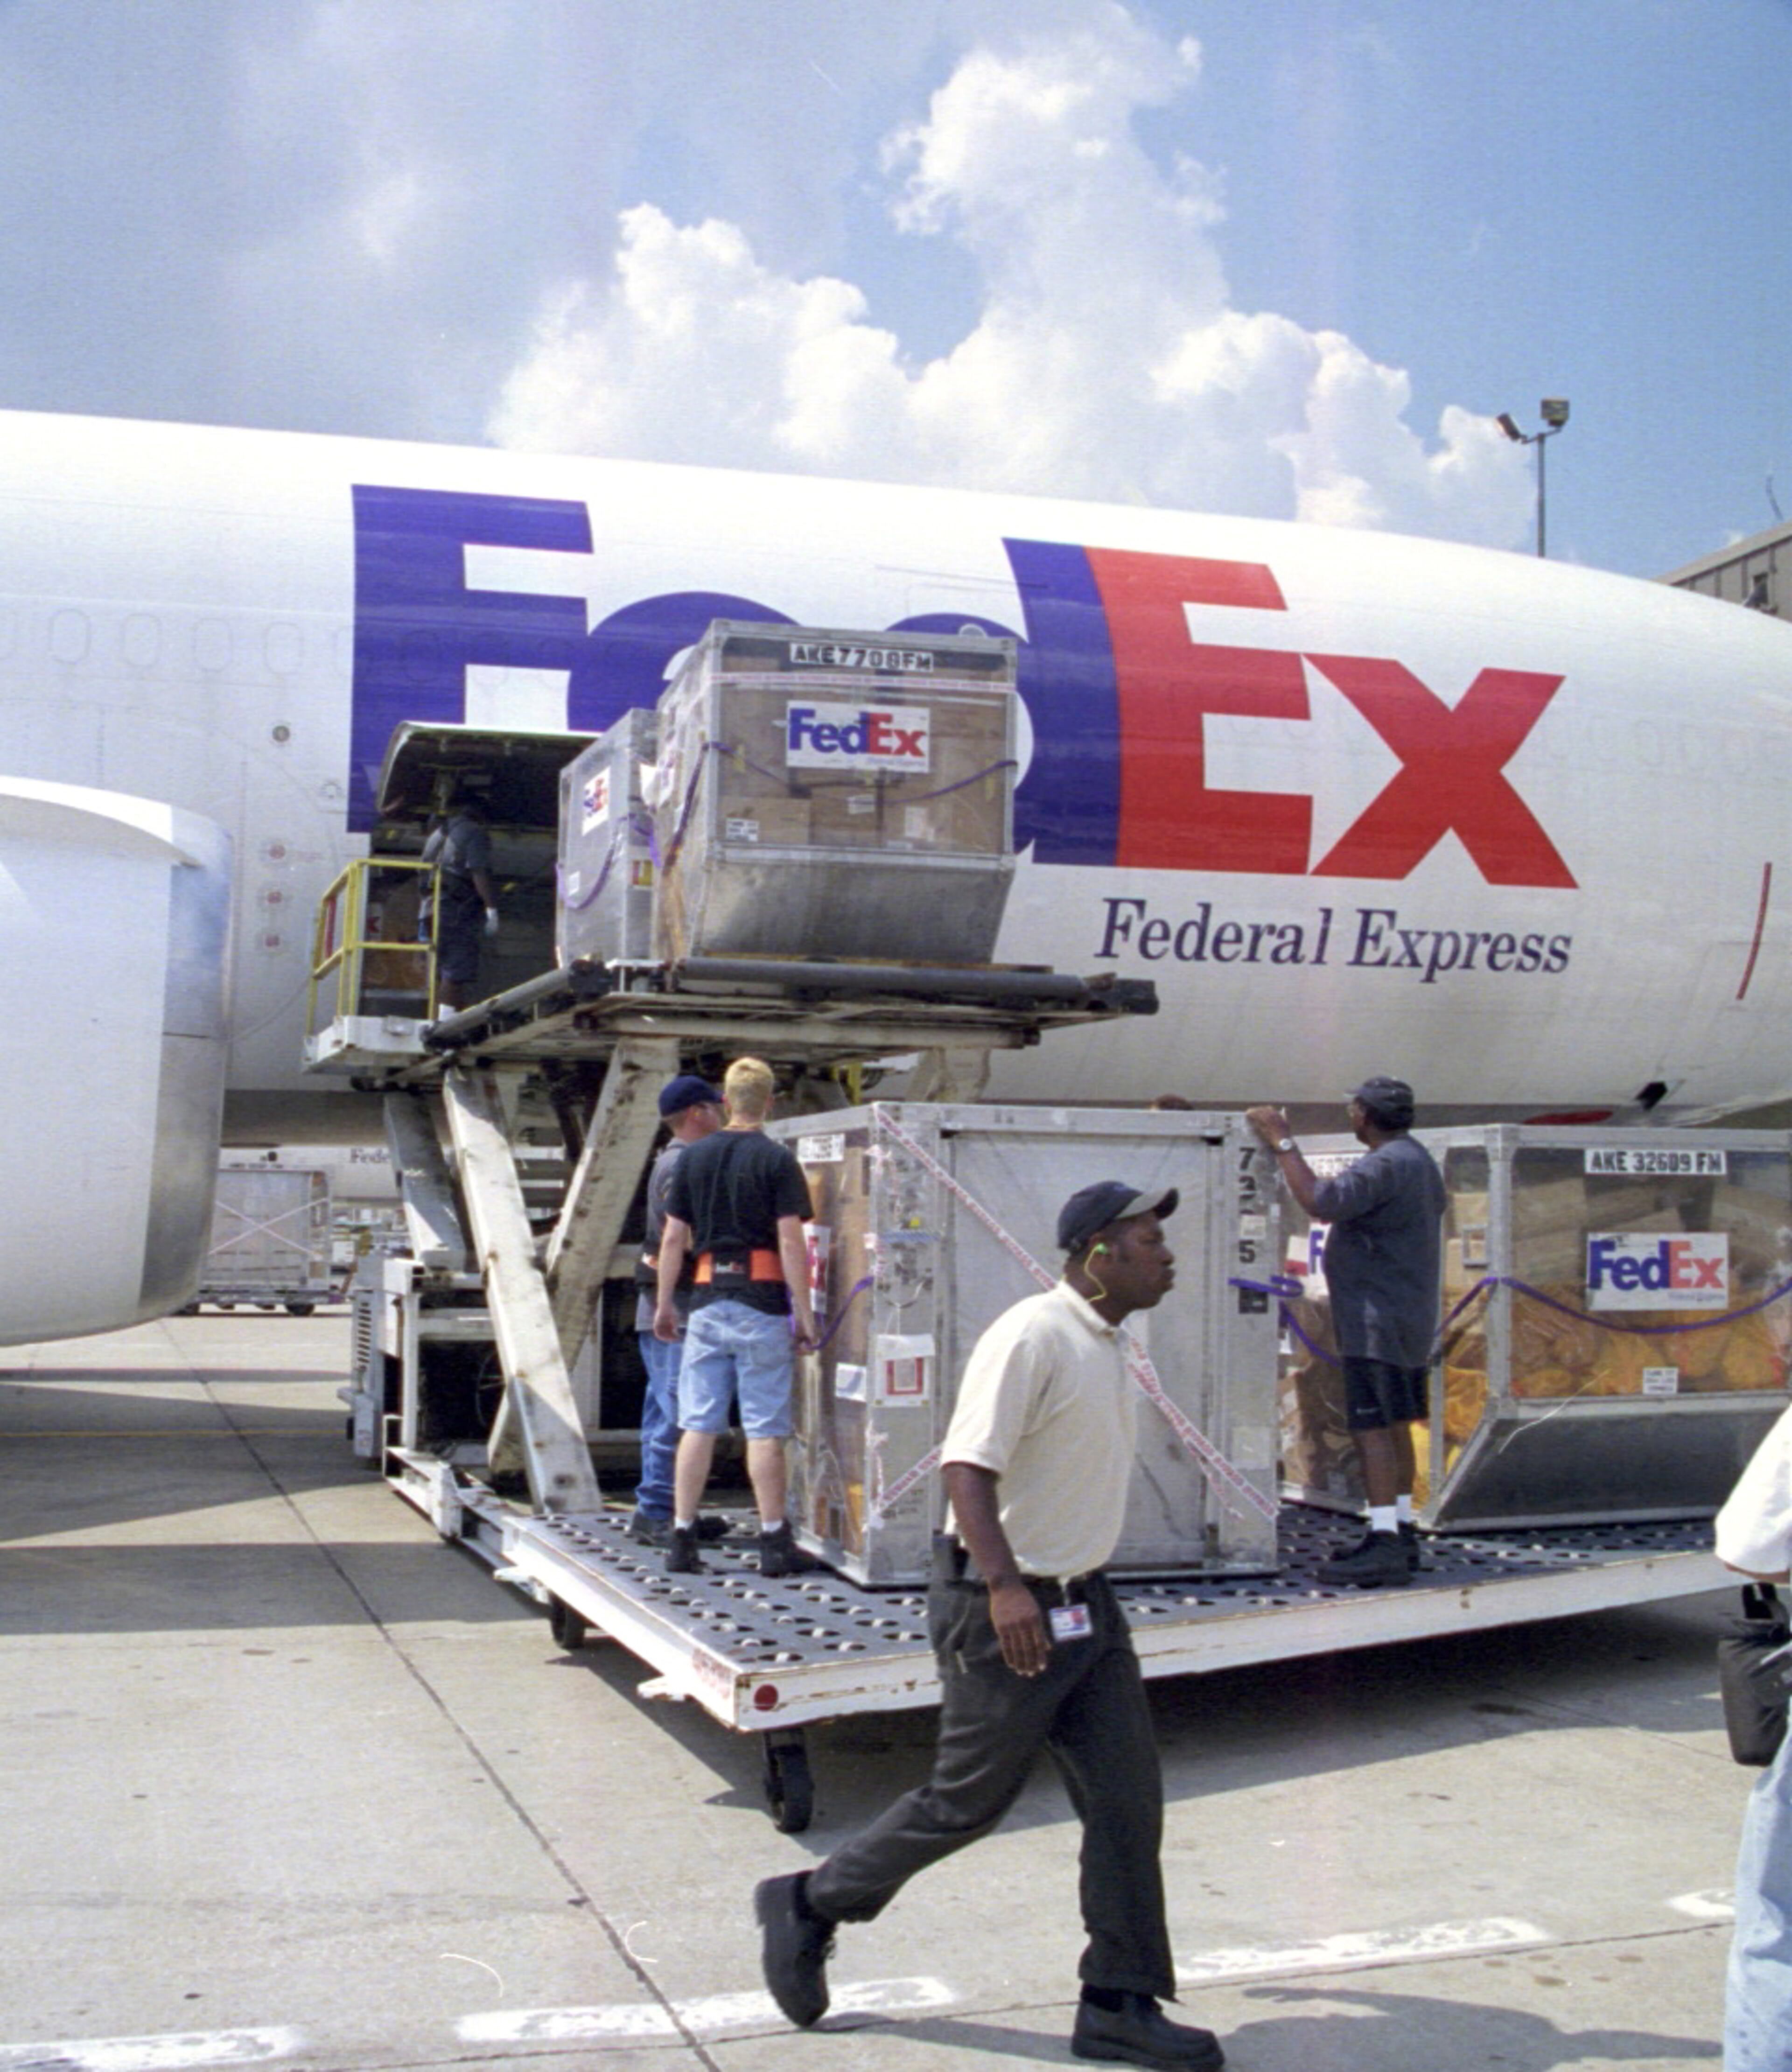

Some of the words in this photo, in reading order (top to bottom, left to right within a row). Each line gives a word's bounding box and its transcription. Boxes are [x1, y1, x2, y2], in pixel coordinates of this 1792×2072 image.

[789, 708, 926, 757] FedEx
[1094, 898, 1333, 966] Federal
[1346, 909, 1573, 982] Express
[1591, 1151, 1628, 1171] AKE
[1589, 1240, 1725, 1291] FedEx
